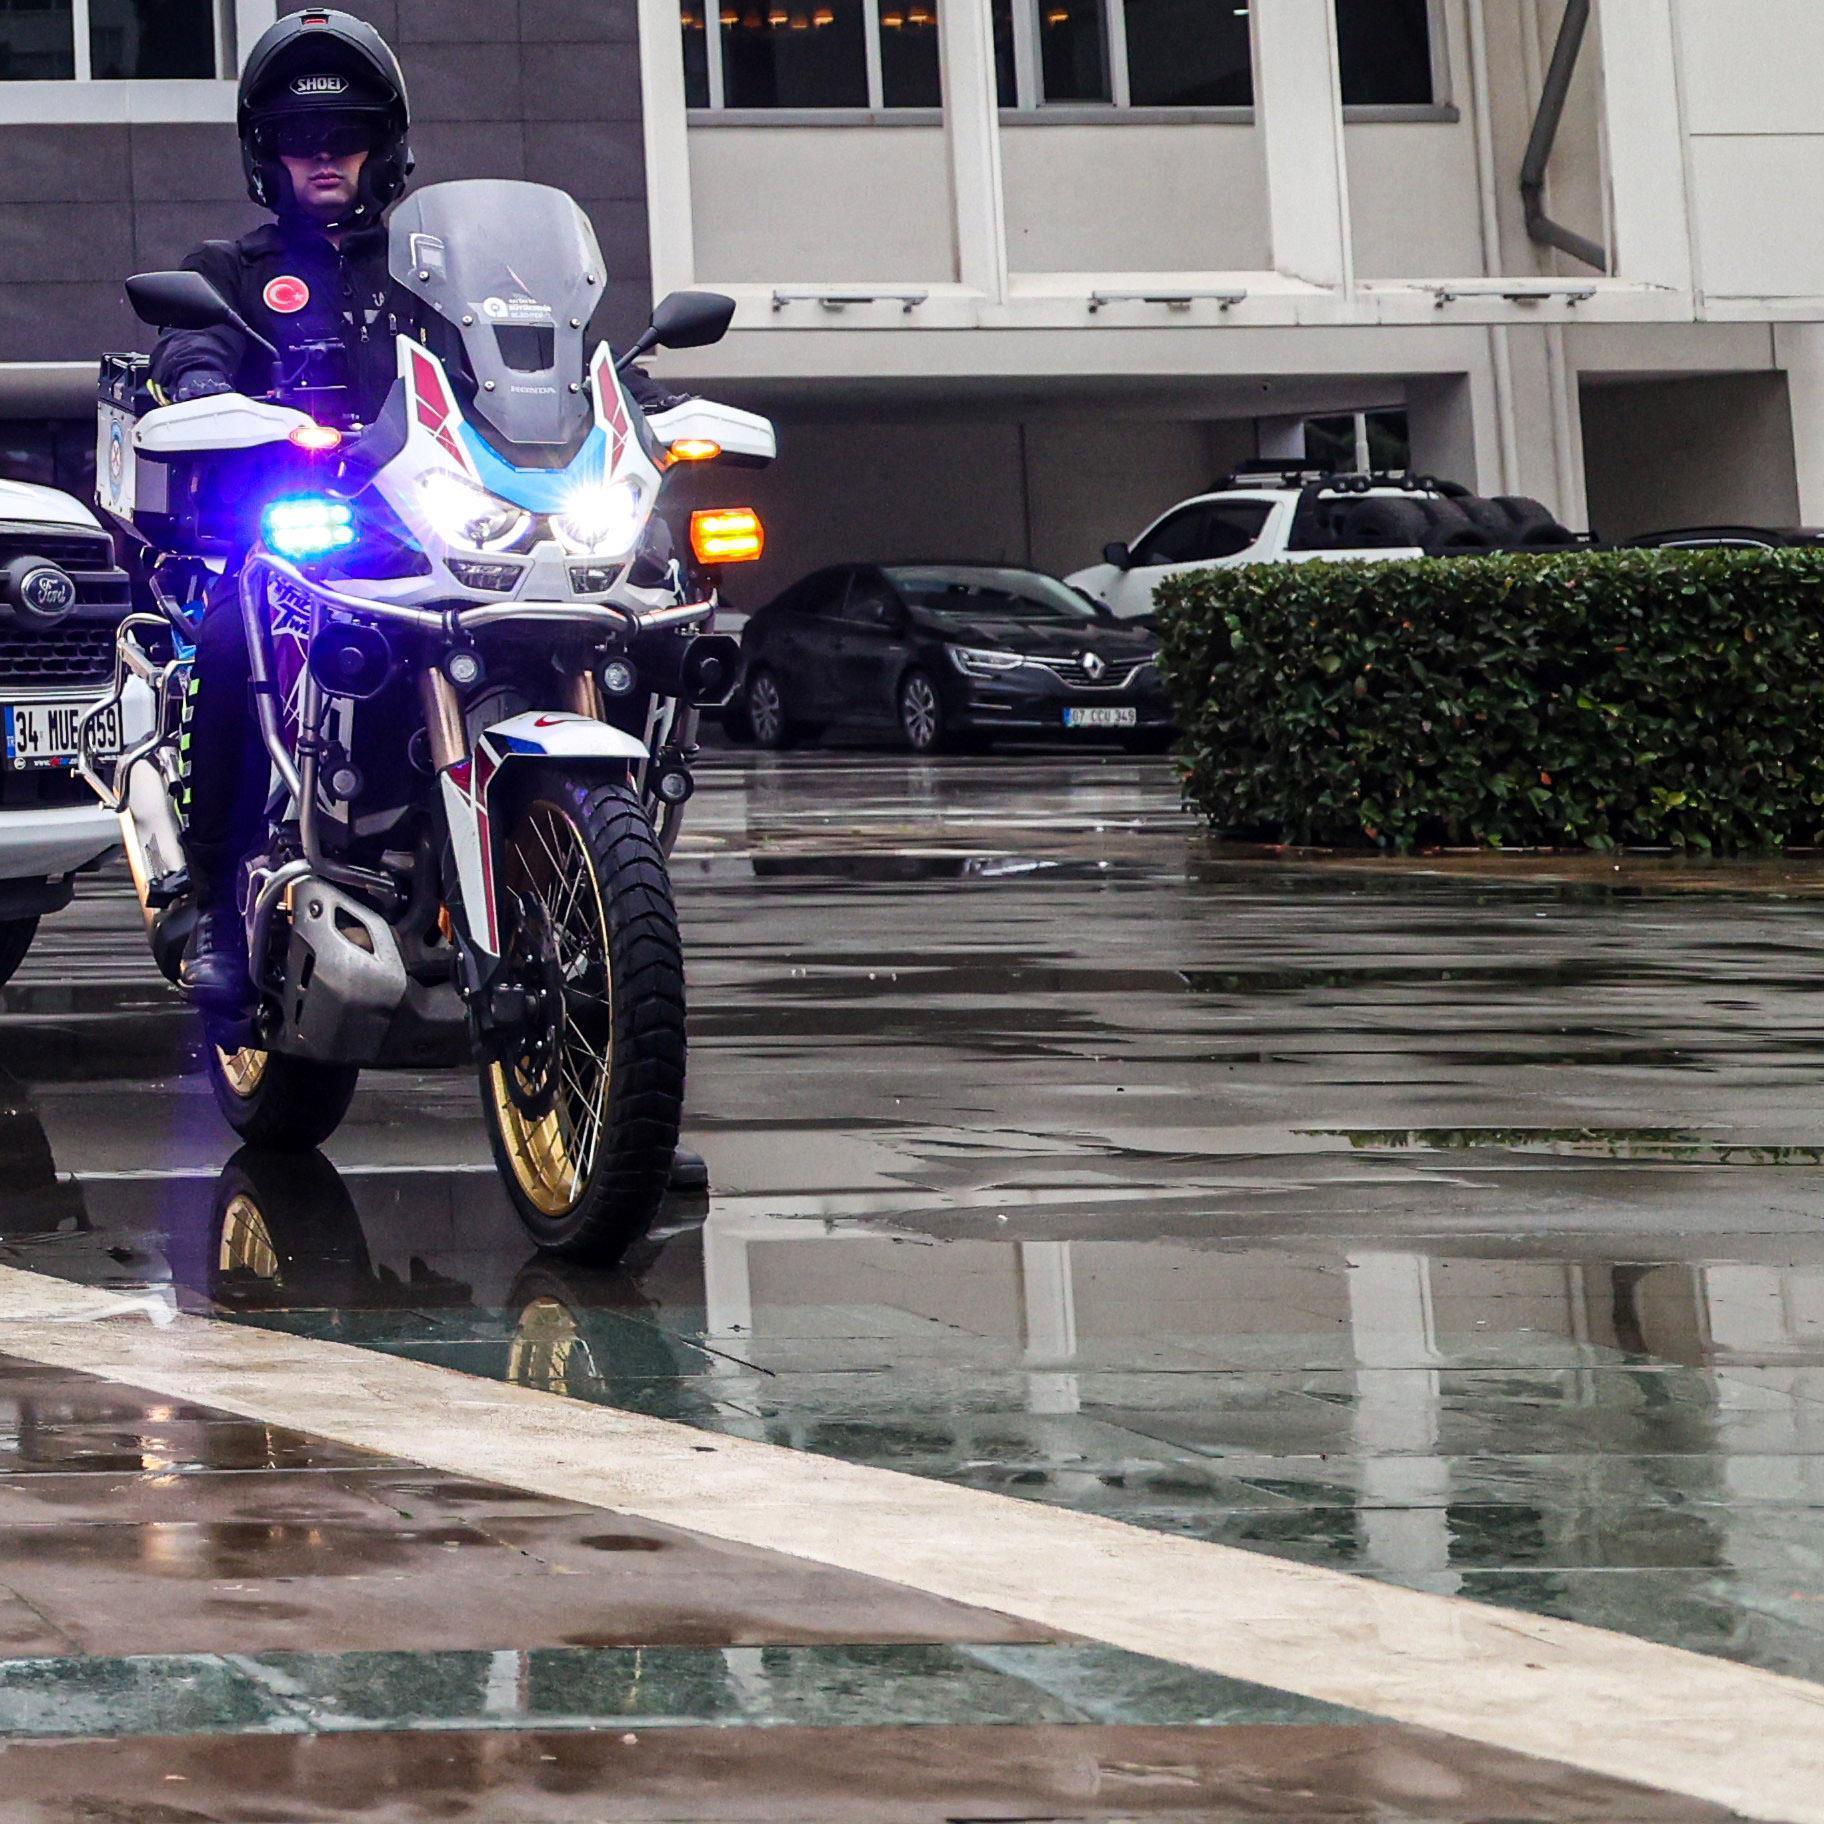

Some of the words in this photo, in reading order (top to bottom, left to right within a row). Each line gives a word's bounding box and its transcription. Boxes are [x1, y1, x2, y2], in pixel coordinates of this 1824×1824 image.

[297, 77, 341, 92] SHOEI
[510, 385, 557, 394] HONDA
[38, 577, 66, 604] Ford
[15, 711, 39, 753] 34
[48, 709, 80, 752] MUE
